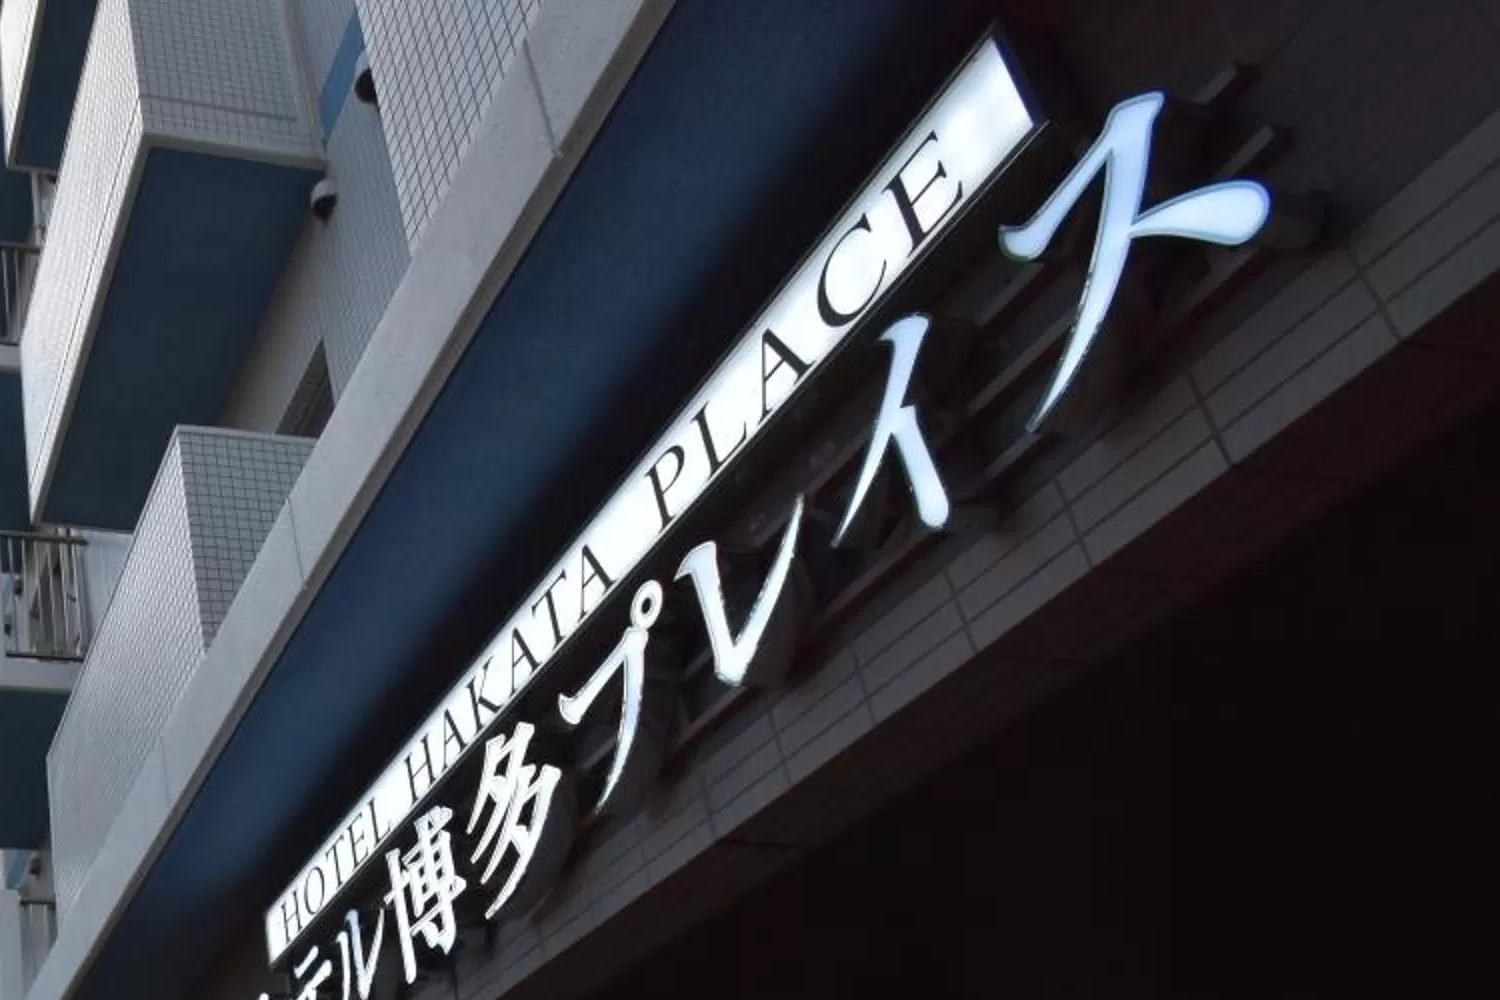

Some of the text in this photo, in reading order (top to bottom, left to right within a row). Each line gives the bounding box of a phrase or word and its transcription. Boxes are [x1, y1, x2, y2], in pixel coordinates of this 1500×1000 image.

[280, 130, 963, 944] HOTEL HAKATA PLACE
